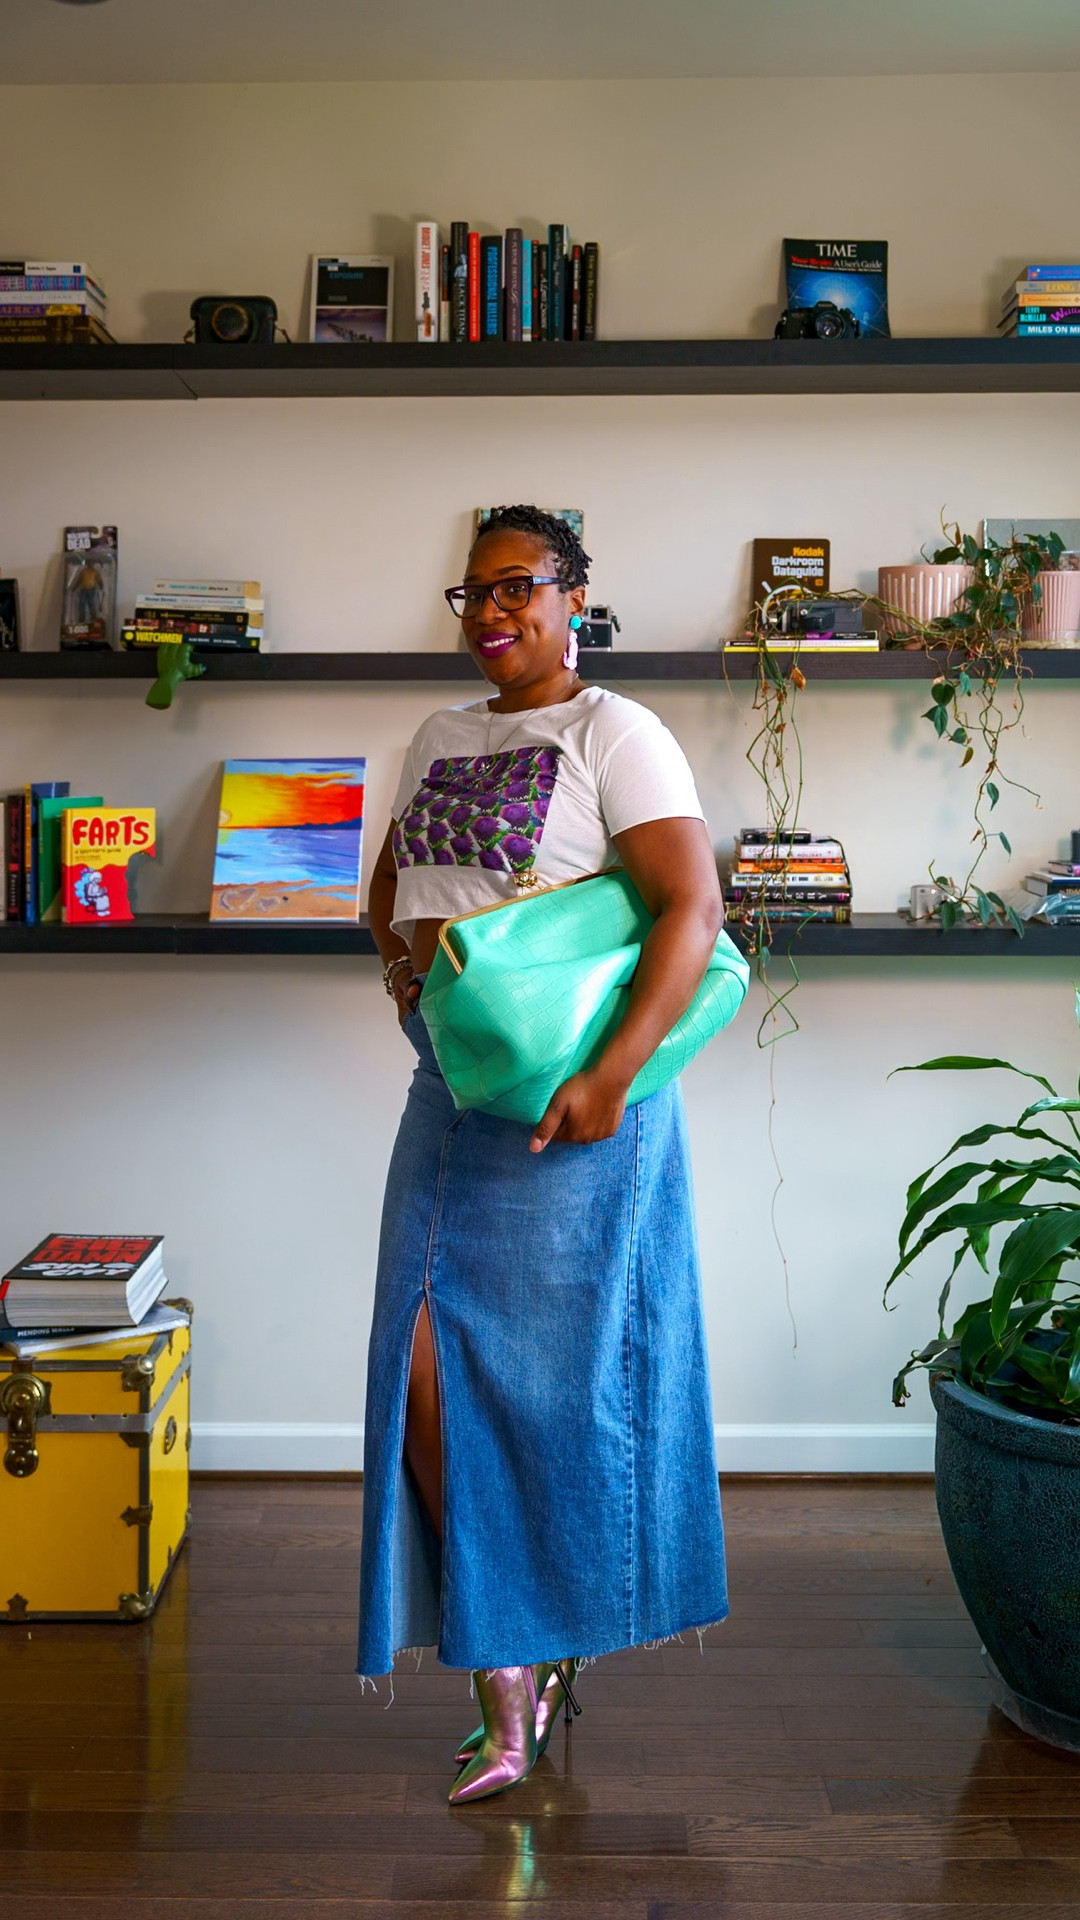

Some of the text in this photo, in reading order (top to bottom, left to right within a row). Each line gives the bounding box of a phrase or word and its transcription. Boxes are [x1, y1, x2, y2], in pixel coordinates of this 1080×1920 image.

[815, 244, 857, 257] TIME
[833, 259, 841, 267] A
[840, 259, 860, 268] User's
[860, 260, 883, 269] Guide
[486, 246, 498, 335] PROFESSIONAL KILLERS
[458, 309, 466, 336] TITAN
[1027, 326, 1053, 334] MILES
[1054, 326, 1068, 334] ON
[67, 538, 91, 550] DEAD
[793, 547, 824, 556] Kodak
[771, 556, 824, 566] Darkroom
[773, 566, 824, 578] Dataguide
[135, 632, 183, 645] WATCHMEN
[72, 816, 150, 846] FARTS
[44, 1237, 154, 1251] BIG
[31, 1249, 145, 1263] DAMN
[21, 1262, 101, 1271] SIN
[41, 1268, 131, 1276] CITY
[17, 1328, 50, 1337] MENDING
